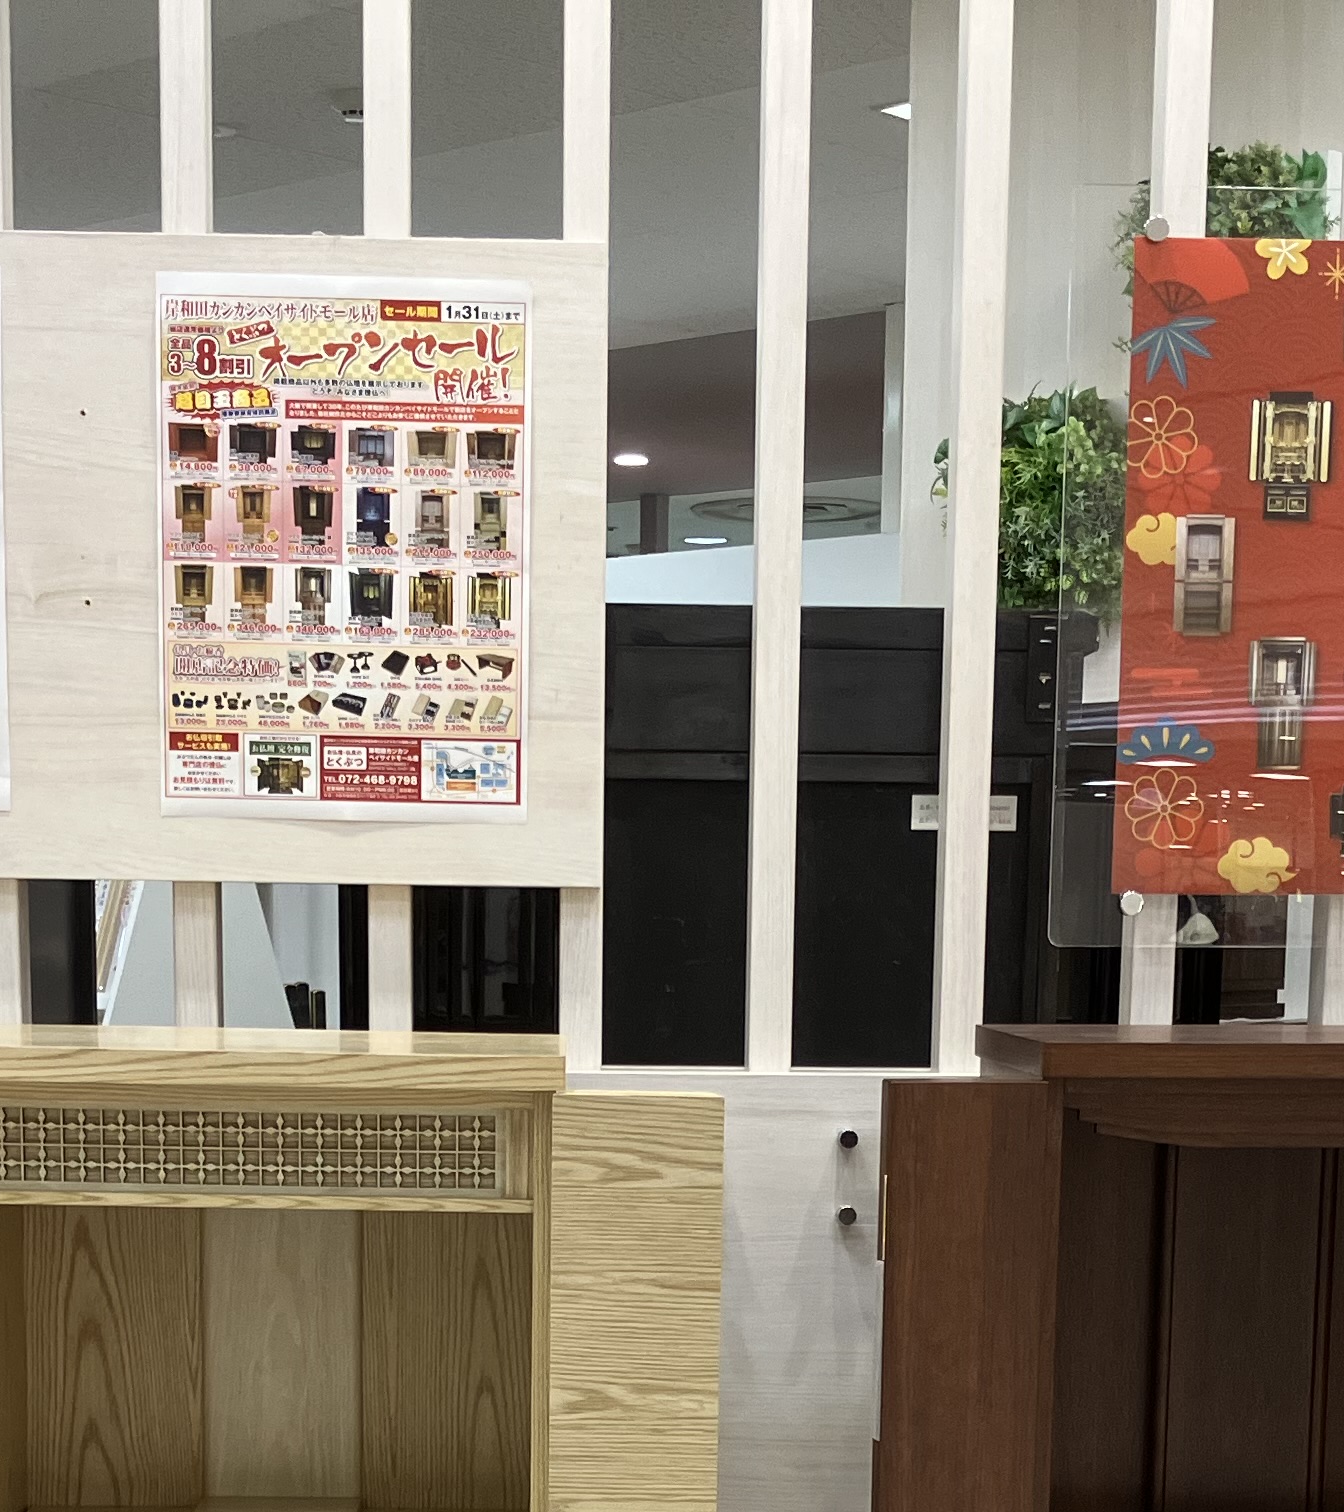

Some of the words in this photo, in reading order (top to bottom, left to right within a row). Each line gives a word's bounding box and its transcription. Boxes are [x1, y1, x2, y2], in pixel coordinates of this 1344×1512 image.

[384, 305, 439, 319] セール期間
[170, 338, 192, 350] 全品
[258, 323, 517, 378] オープンセール
